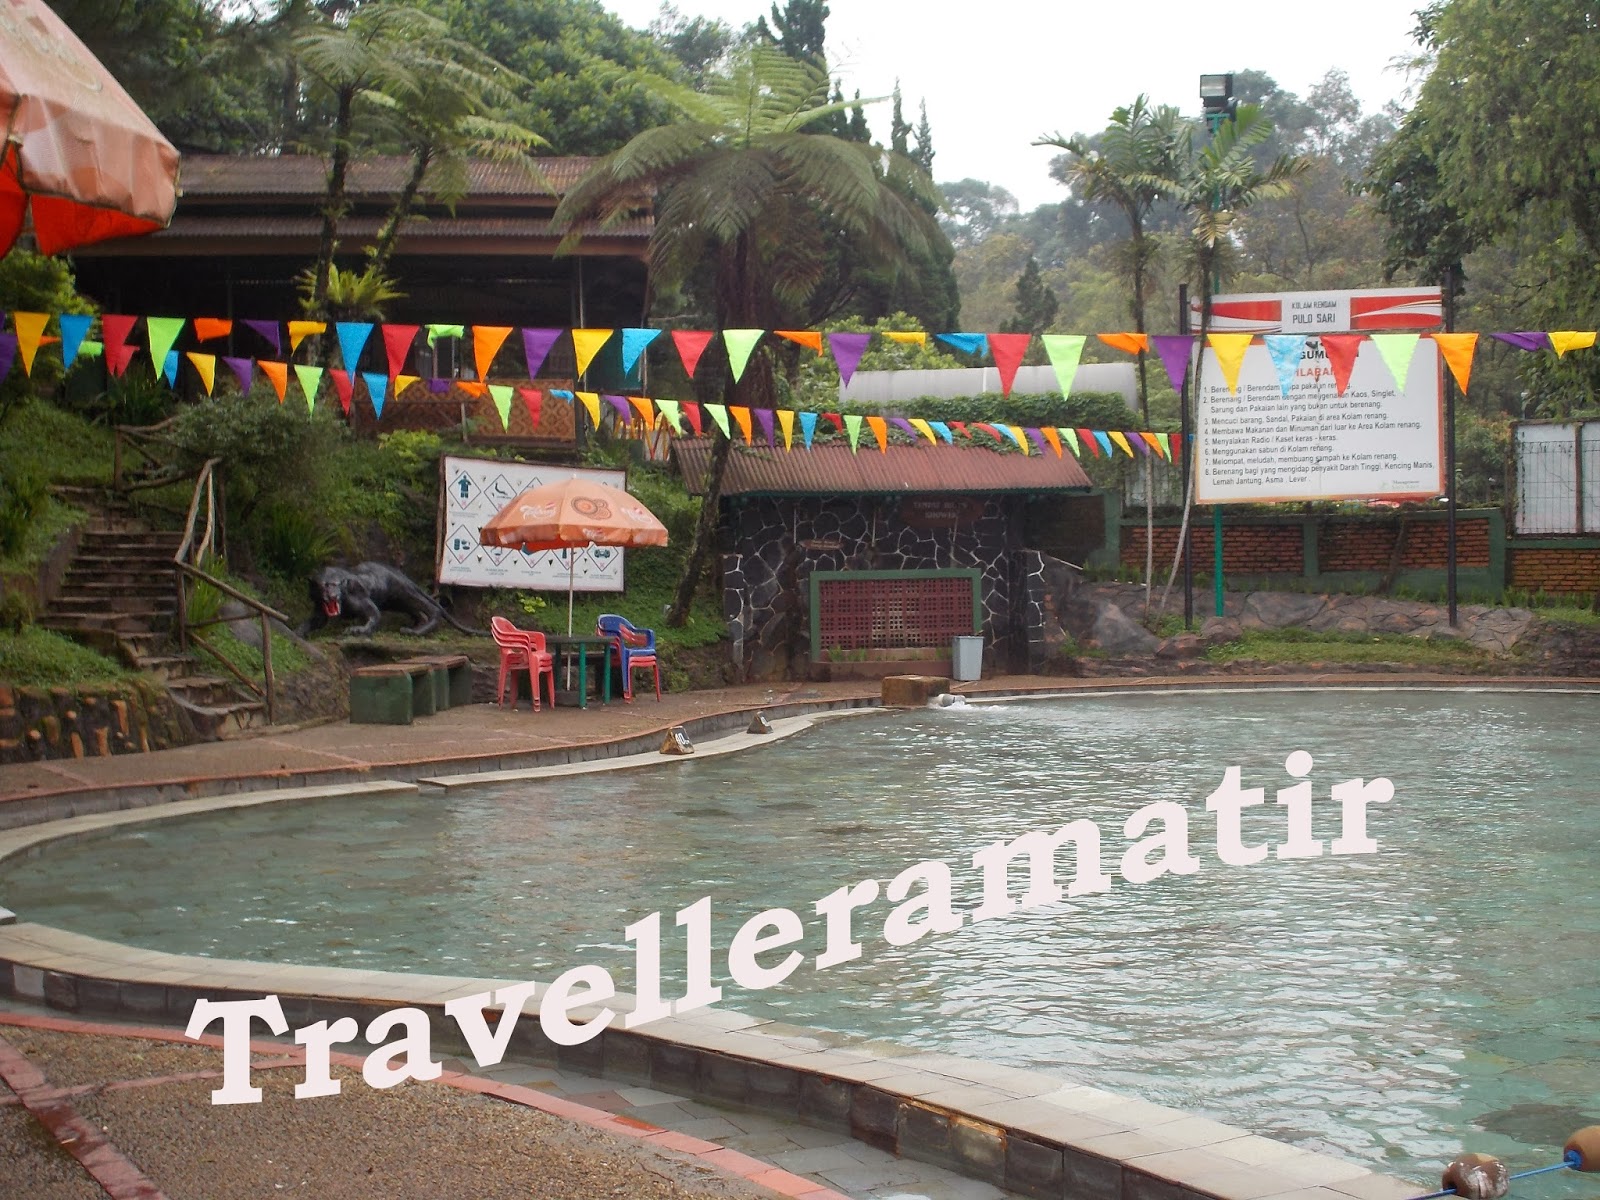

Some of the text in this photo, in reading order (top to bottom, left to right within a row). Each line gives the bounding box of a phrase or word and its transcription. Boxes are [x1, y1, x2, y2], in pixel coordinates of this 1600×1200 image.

[1291, 301, 1312, 309] KOLAM
[1292, 312, 1336, 324] PULO SARI
[1290, 403, 1306, 412] yang
[1358, 422, 1373, 430] Area
